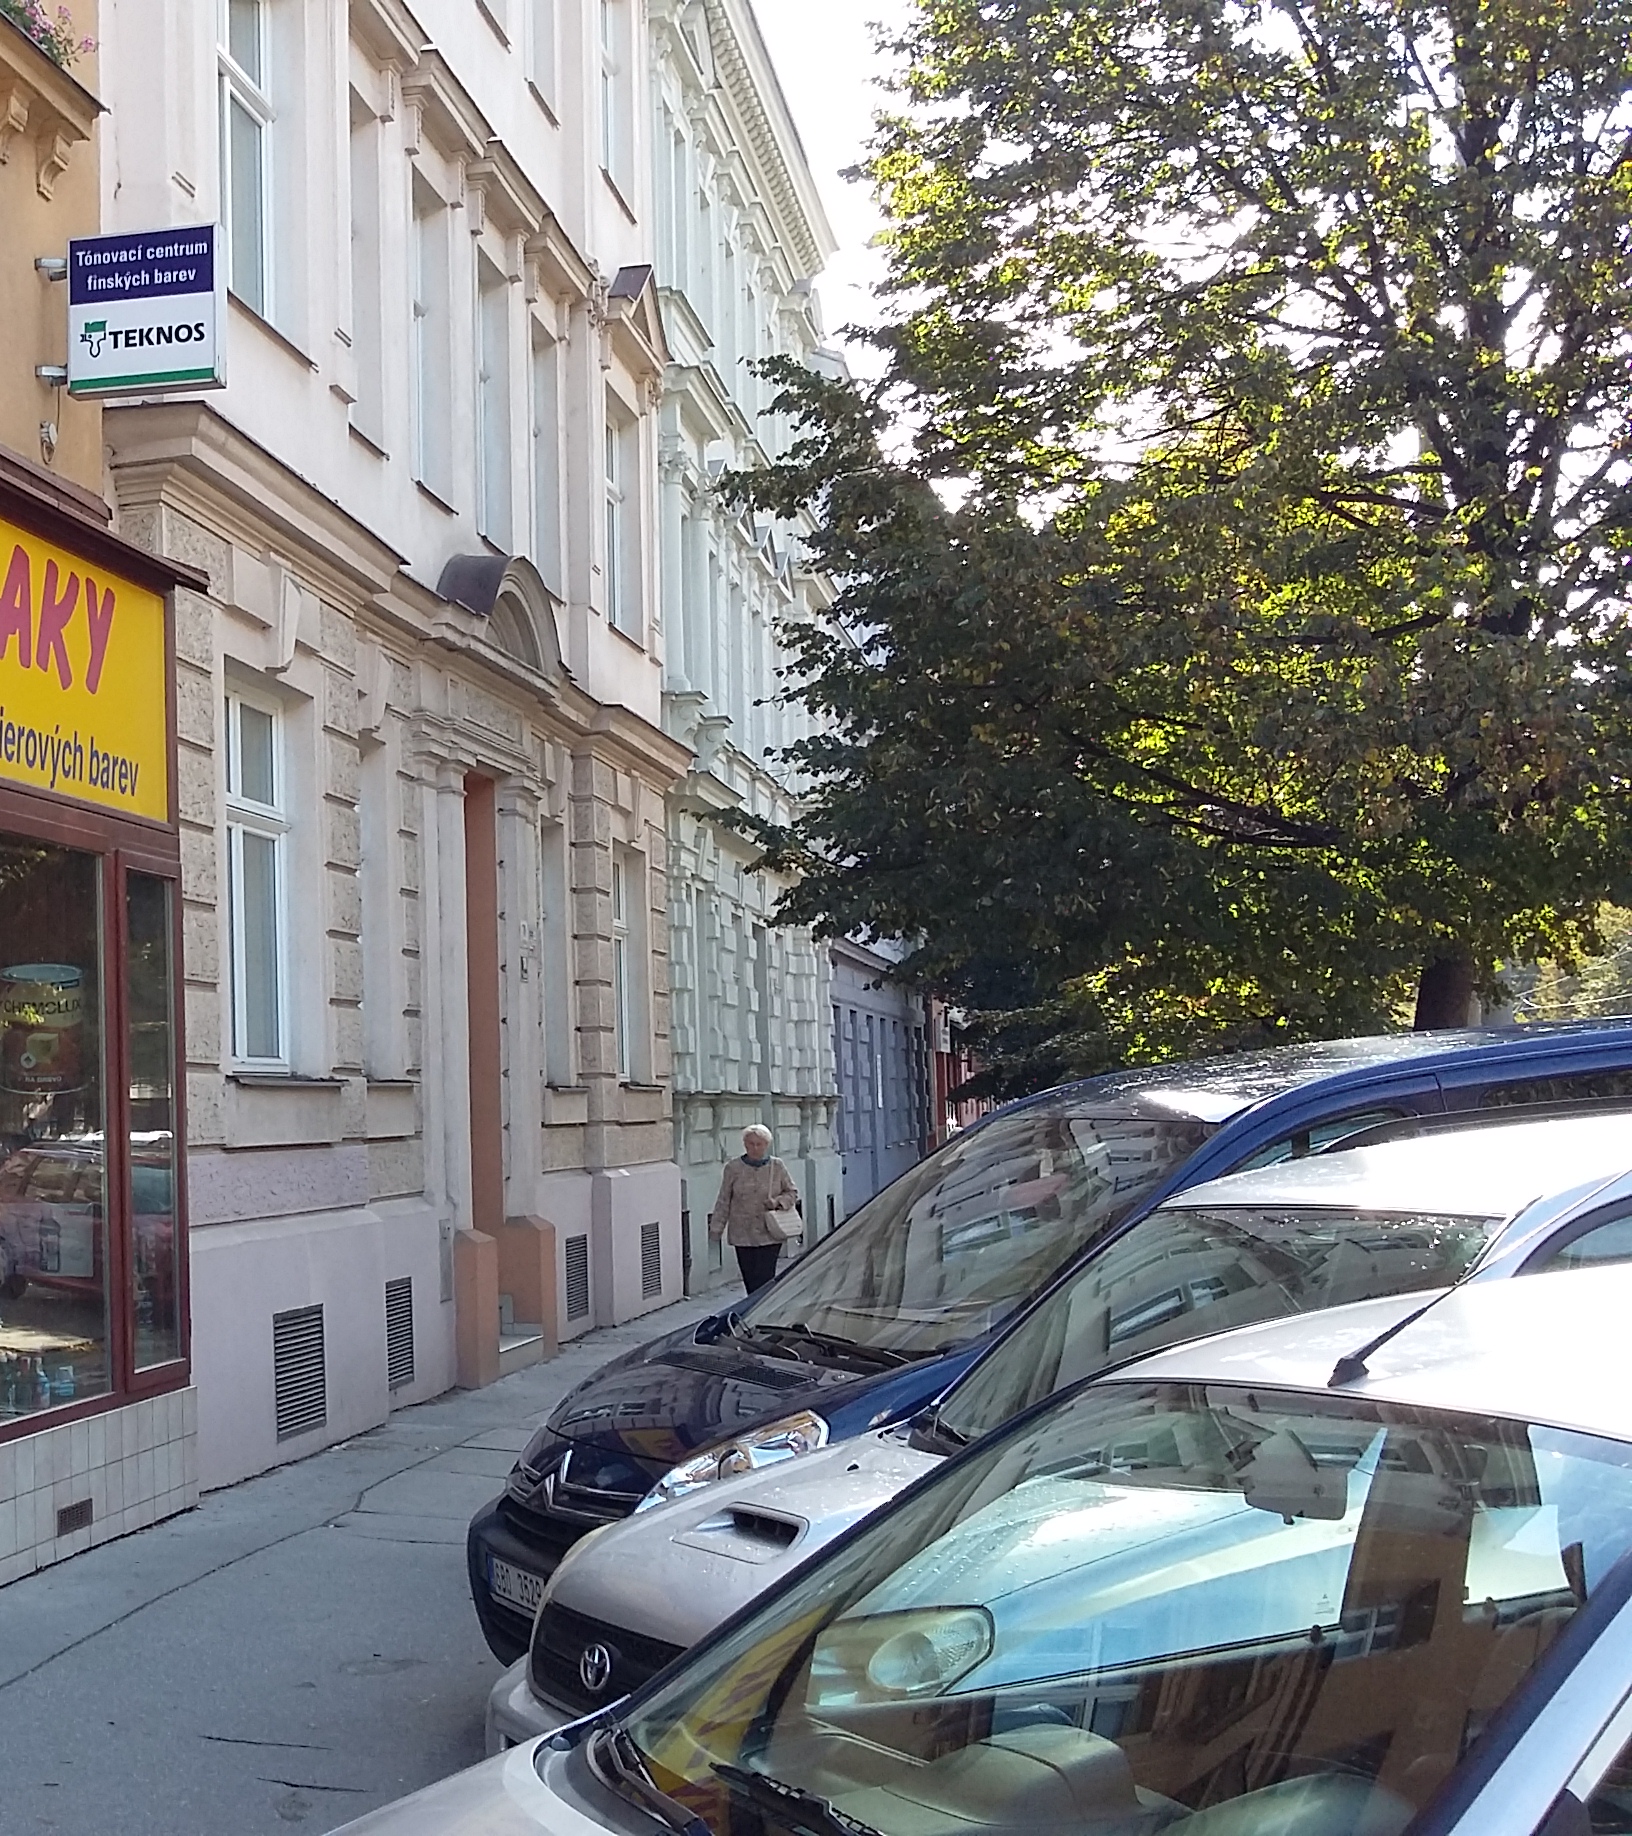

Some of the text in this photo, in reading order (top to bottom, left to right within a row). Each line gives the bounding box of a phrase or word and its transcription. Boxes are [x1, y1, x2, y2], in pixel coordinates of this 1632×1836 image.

[76, 240, 208, 267] Tónovací centrum
[87, 268, 197, 291] finských barev
[108, 322, 206, 350] TEKNOS
[88, 736, 139, 797] barev
